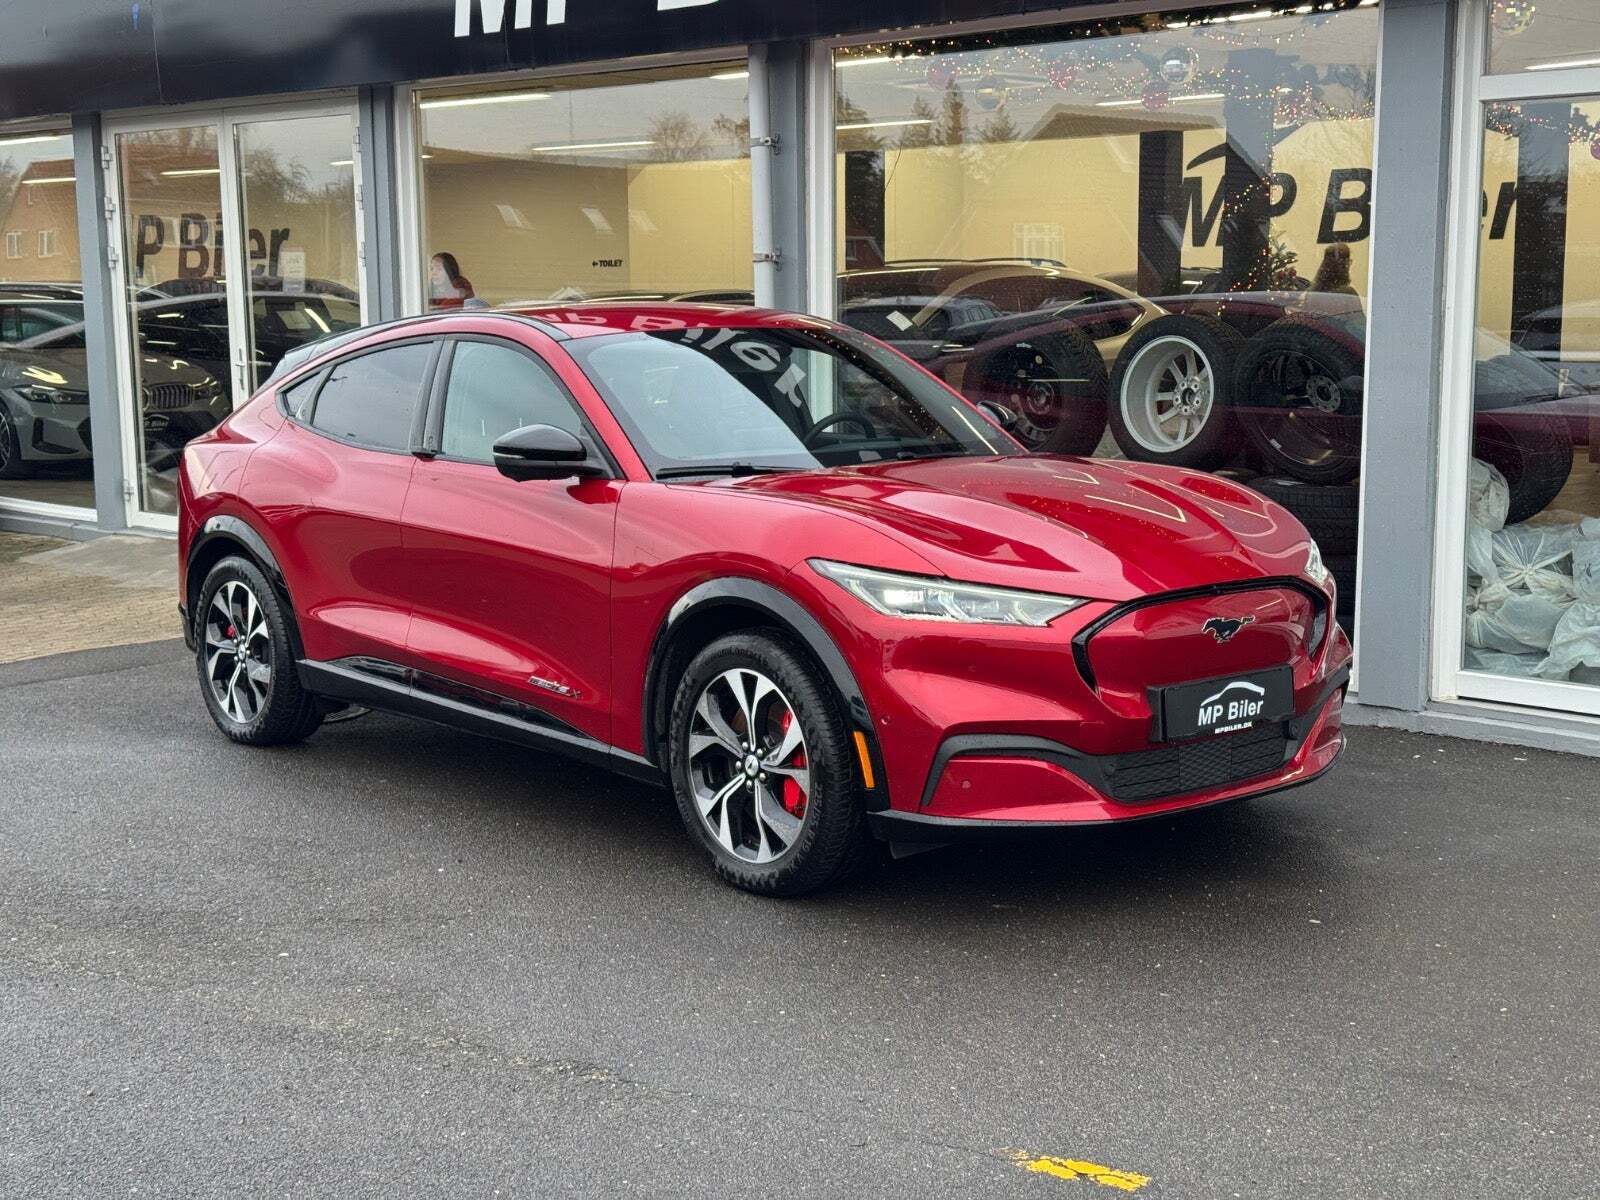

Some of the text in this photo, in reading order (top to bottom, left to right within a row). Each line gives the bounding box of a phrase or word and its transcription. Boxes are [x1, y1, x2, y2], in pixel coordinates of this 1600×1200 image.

[178, 212, 290, 280] Bier
[599, 259, 624, 268] TOILET
[1197, 699, 1263, 726] MP Biler
